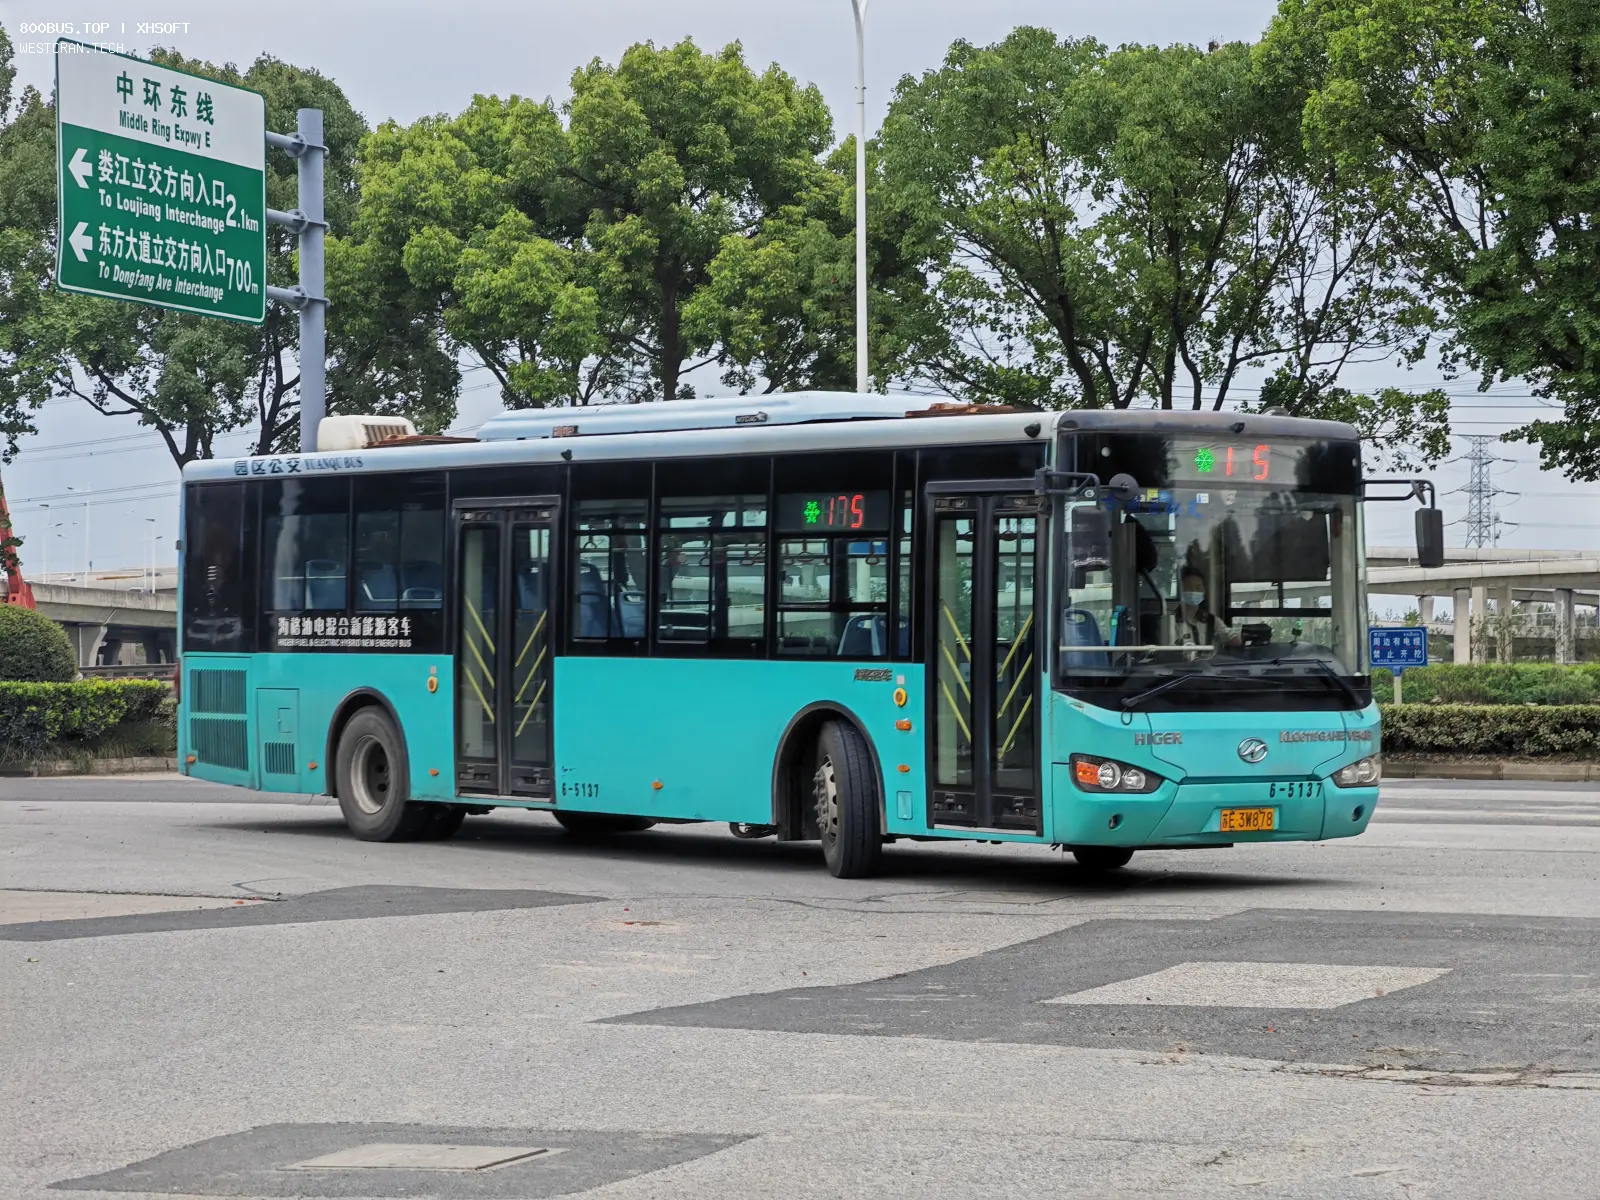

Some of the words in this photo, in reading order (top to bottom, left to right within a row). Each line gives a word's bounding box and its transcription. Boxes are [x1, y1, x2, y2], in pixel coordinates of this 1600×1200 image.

[116, 71, 214, 125] 中环东线
[119, 110, 148, 132] Middle
[152, 118, 171, 142] Ring
[174, 124, 202, 149] Expwy
[204, 131, 211, 148] E
[98, 149, 225, 208] 娄江立交方向入口
[225, 194, 259, 232] 2.1km
[98, 189, 112, 207] To
[116, 192, 161, 222] Loujiang
[165, 203, 225, 235] Interchange
[98, 222, 226, 277] 东方大道立交方向入口
[226, 258, 259, 295] 700m
[98, 261, 110, 279] To
[112, 264, 155, 292] Dongfang
[155, 273, 172, 291] Ave
[174, 275, 224, 304] Interchange
[234, 458, 301, 476] 园区公交
[828, 494, 864, 528] 175
[1134, 731, 1183, 746] HIGER
[561, 782, 599, 798] 6-5137
[1269, 782, 1321, 798] 6-5137
